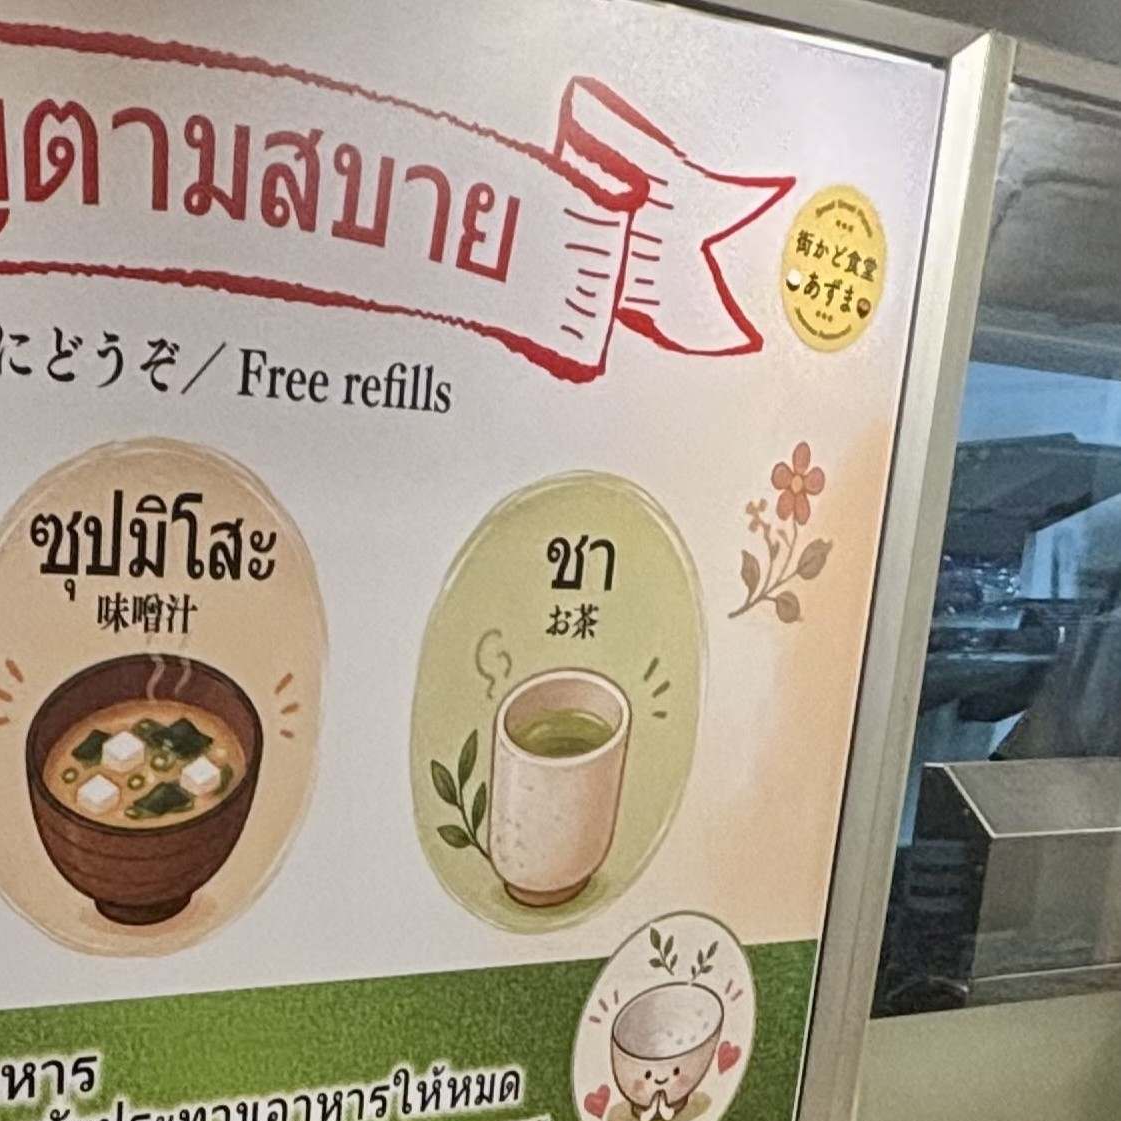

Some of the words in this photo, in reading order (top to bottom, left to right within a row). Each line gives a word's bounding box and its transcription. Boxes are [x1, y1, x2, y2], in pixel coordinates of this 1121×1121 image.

[804, 272, 854, 312] あずま
[239, 348, 330, 405] Free
[343, 365, 453, 415] refills
[30, 489, 277, 601] ซุปมิโสะ
[547, 535, 615, 591] ชา
[96, 592, 198, 634] 味噌汁
[546, 603, 599, 639] お茶
